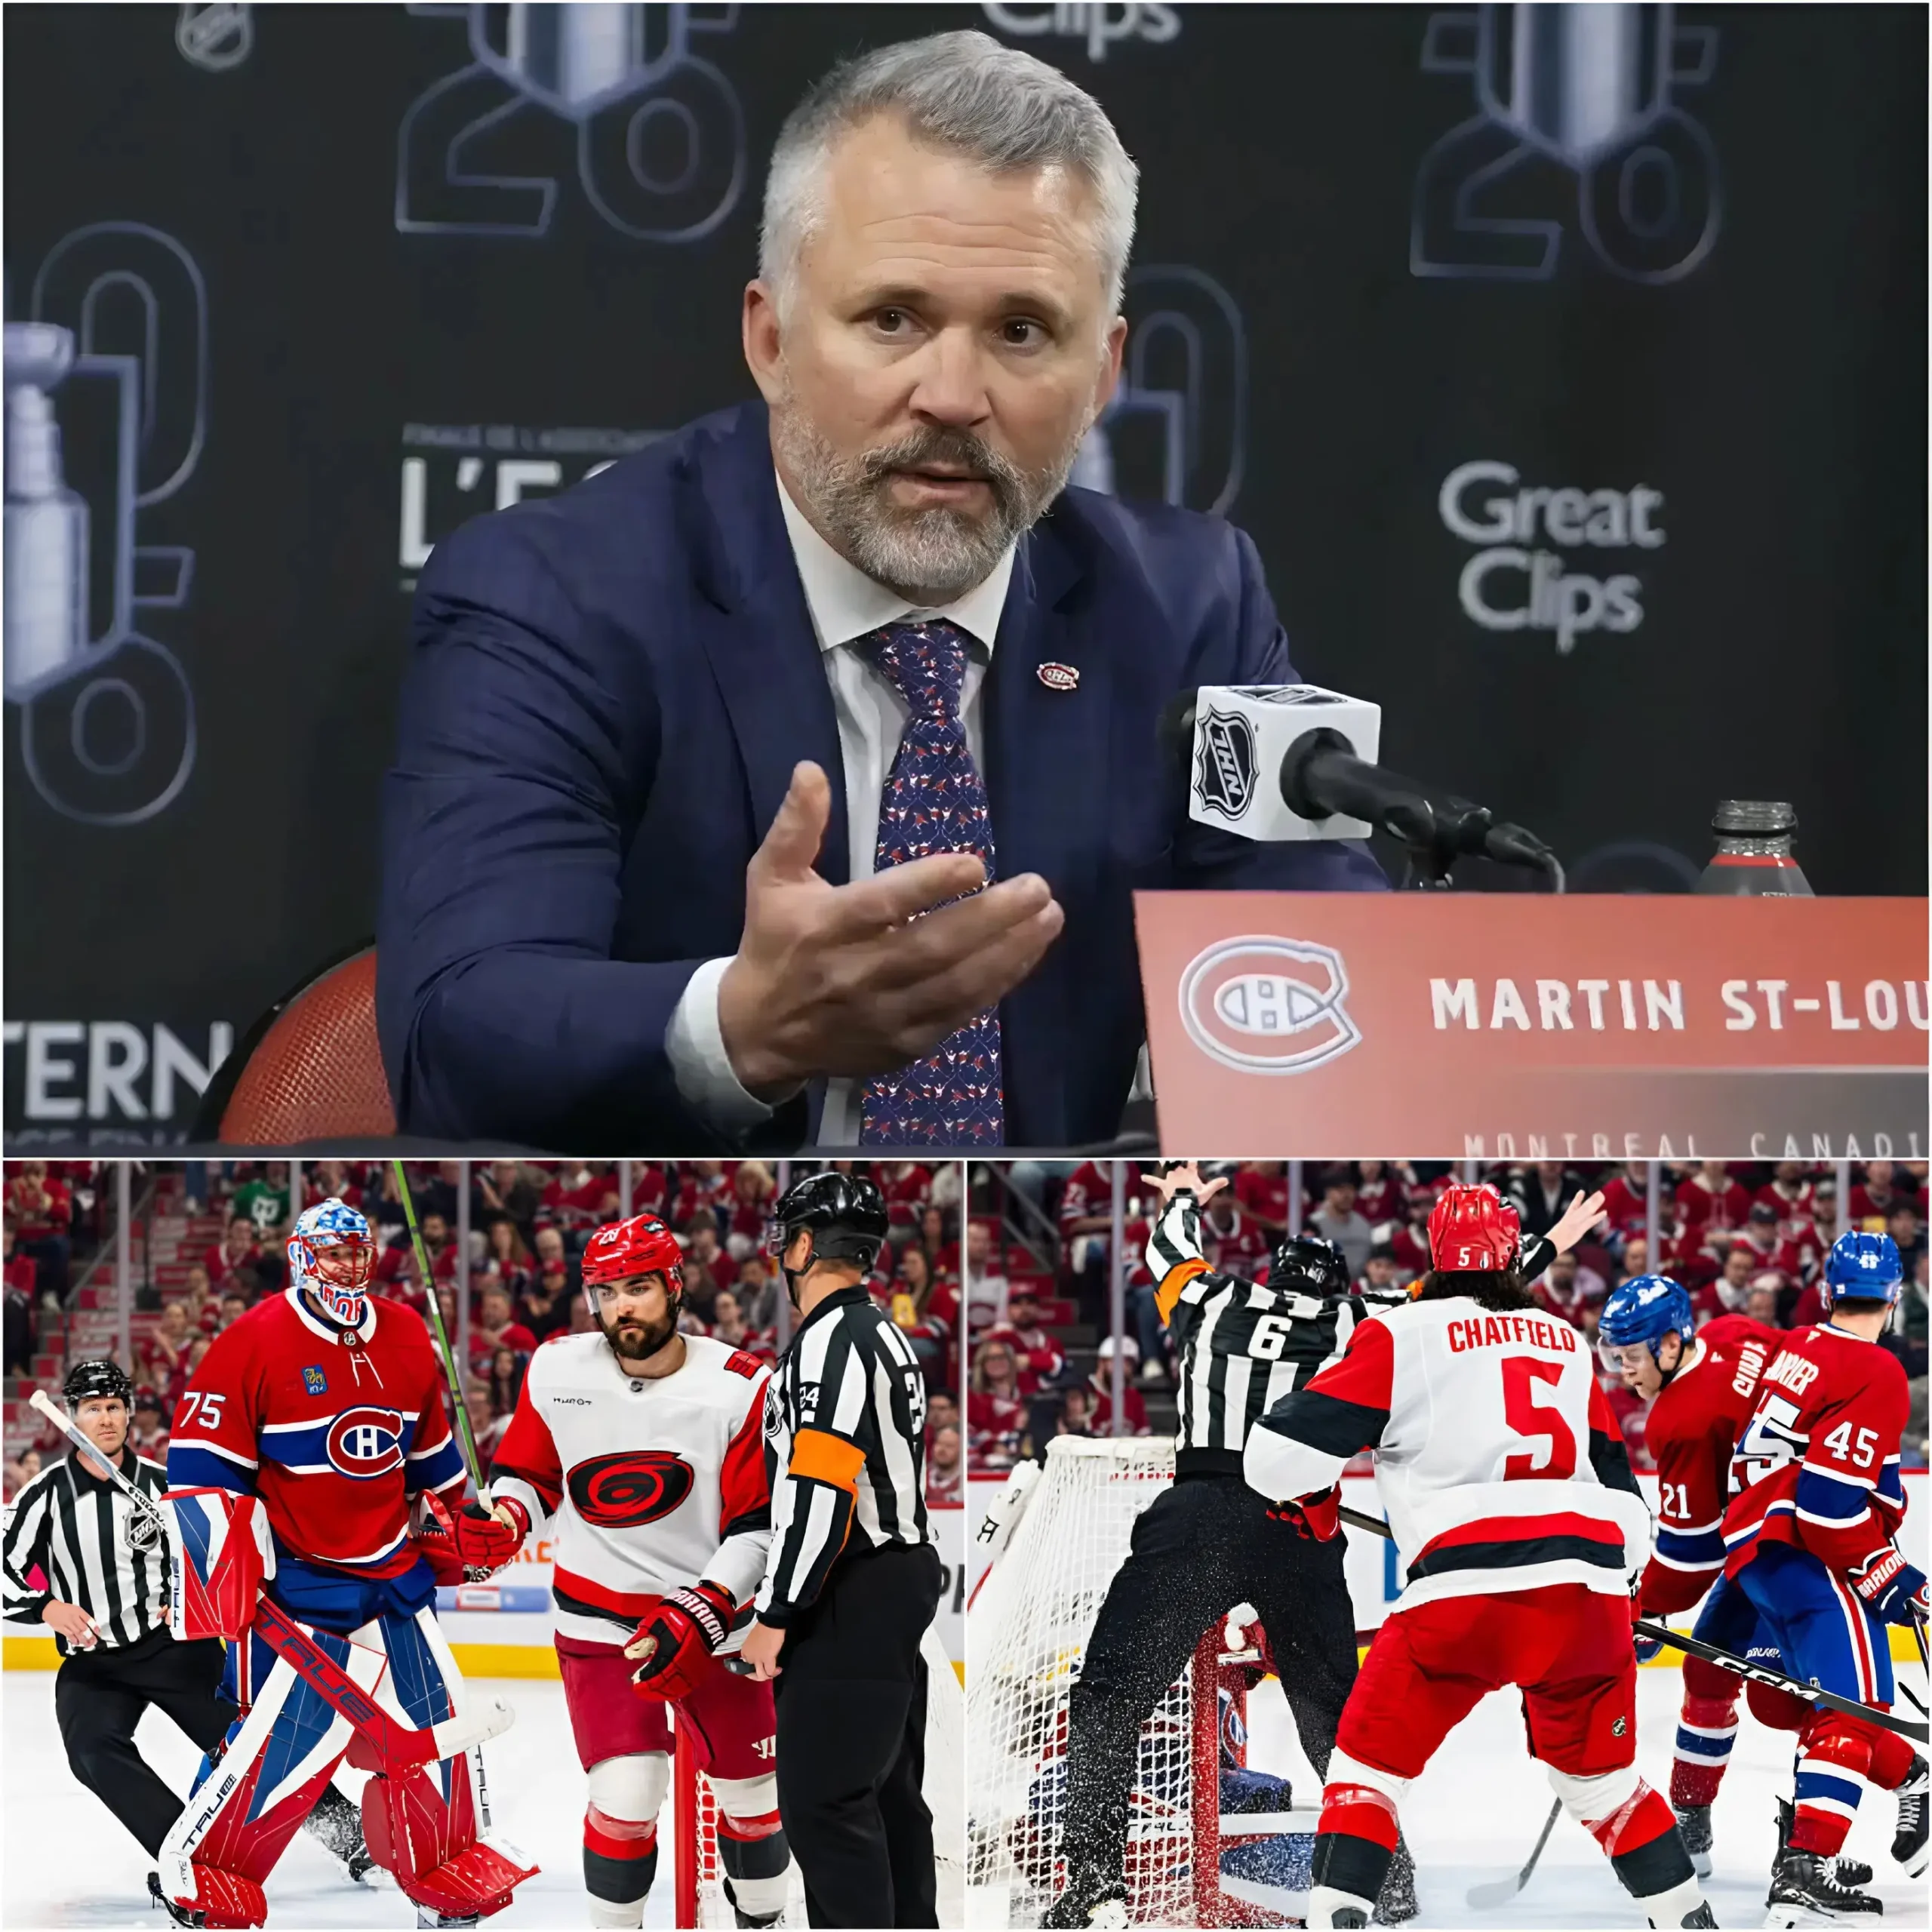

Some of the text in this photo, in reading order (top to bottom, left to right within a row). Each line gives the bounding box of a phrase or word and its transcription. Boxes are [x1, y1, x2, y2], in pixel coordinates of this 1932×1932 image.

[1438, 460, 1666, 548] Great
[1458, 546, 1644, 656] Clips
[1217, 729, 1244, 796] NHL
[1429, 978, 1685, 1032] MARTIN
[1457, 1247, 1471, 1267] 5
[1247, 1315, 1293, 1361] 6
[1447, 1316, 1576, 1353] CHATFIELD
[179, 1391, 226, 1430] 75
[1500, 1355, 1577, 1482] 5
[1823, 1420, 1881, 1469] 45
[1662, 1482, 1692, 1519] 21
[1712, 1656, 1821, 1701] CCM
